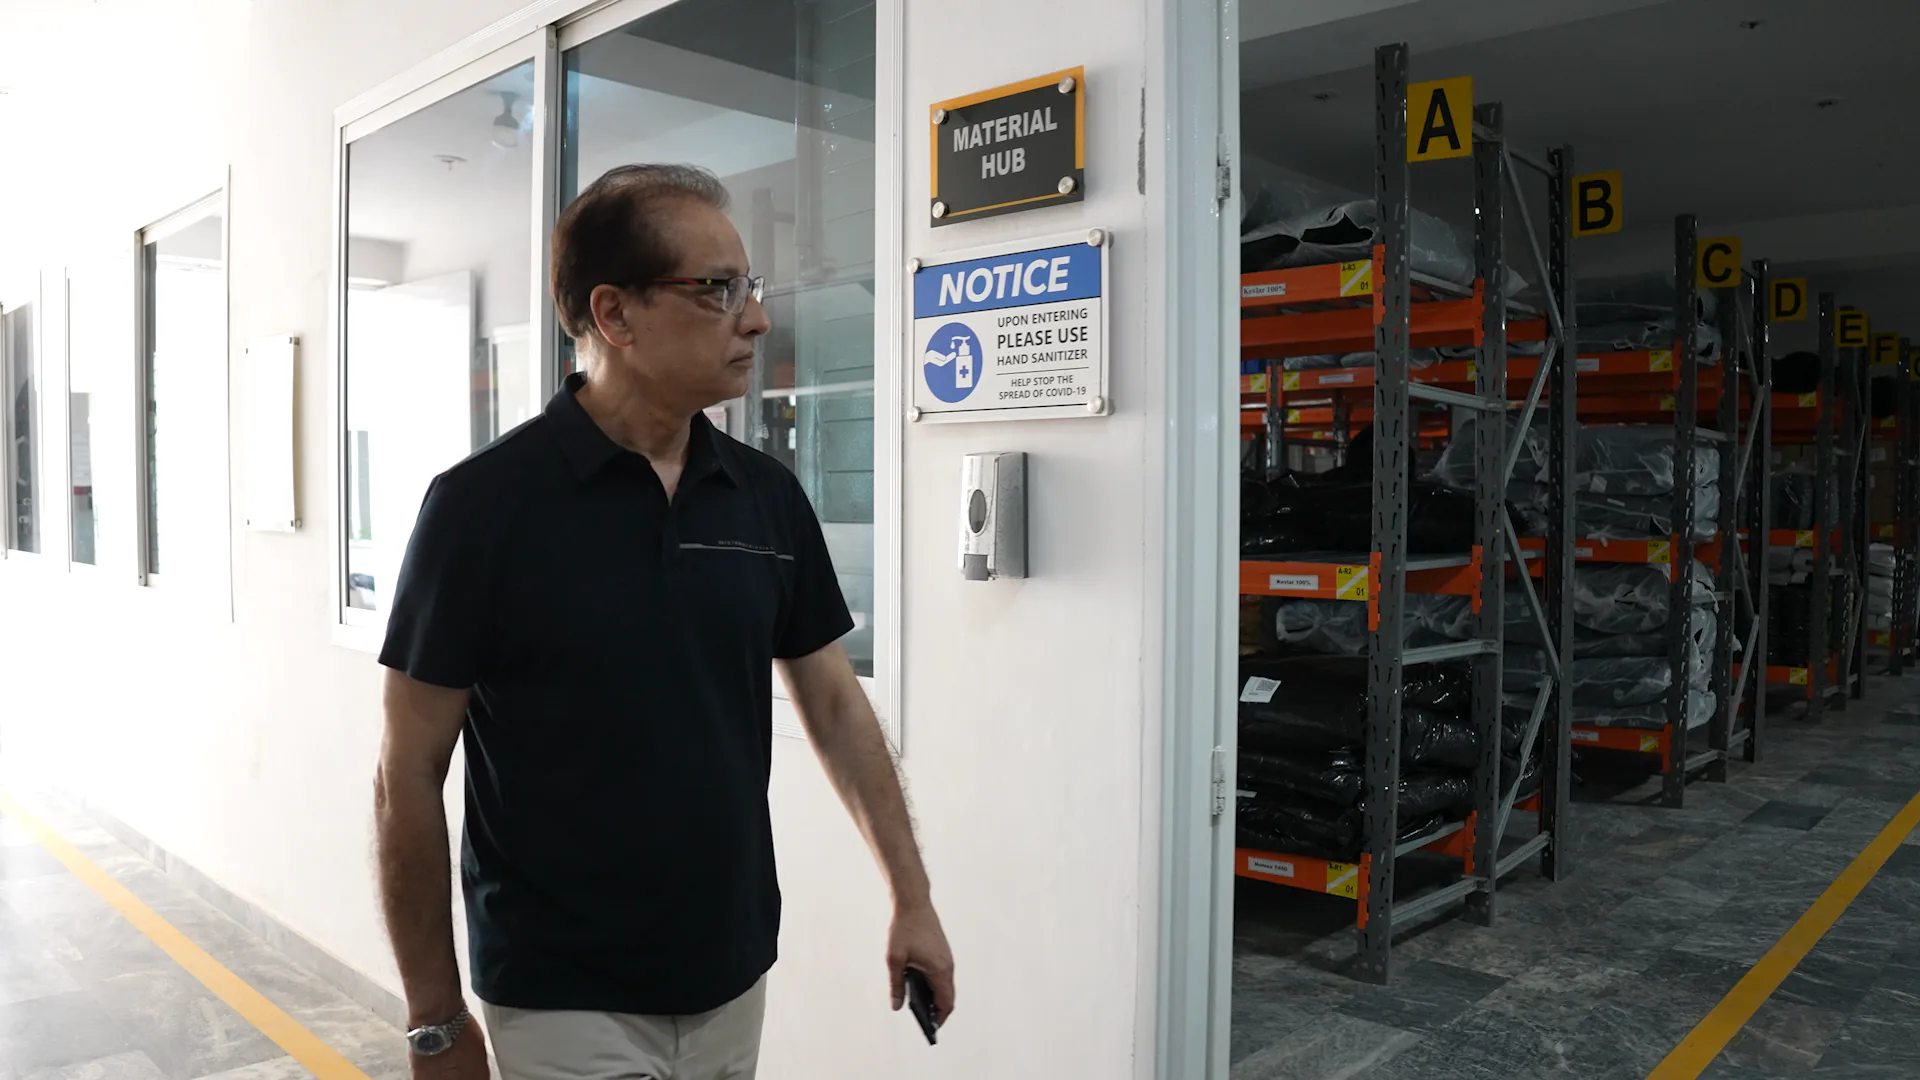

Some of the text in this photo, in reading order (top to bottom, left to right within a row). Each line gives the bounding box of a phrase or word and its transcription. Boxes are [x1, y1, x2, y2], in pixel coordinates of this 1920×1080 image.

[953, 106, 1057, 152] MATERIAL
[1417, 88, 1461, 154] A
[981, 147, 1026, 180] HUB
[1578, 179, 1614, 231] B
[1702, 242, 1732, 283] C
[938, 255, 1071, 307] NOTICE
[1360, 281, 1369, 290] 01
[1775, 282, 1801, 318] D
[997, 308, 1088, 328] UPON ENTERING
[1840, 314, 1863, 344] E
[997, 326, 1088, 349] PLEASE USE
[1875, 335, 1894, 362] F
[997, 348, 1088, 366] HAND SANITIZER
[998, 386, 1086, 400] SPREAD OF COVID-19
[1011, 375, 1073, 387] HELP STOP THE
[1338, 566, 1352, 575] A-R2
[1355, 587, 1365, 596] 01
[1345, 885, 1354, 894] 01
